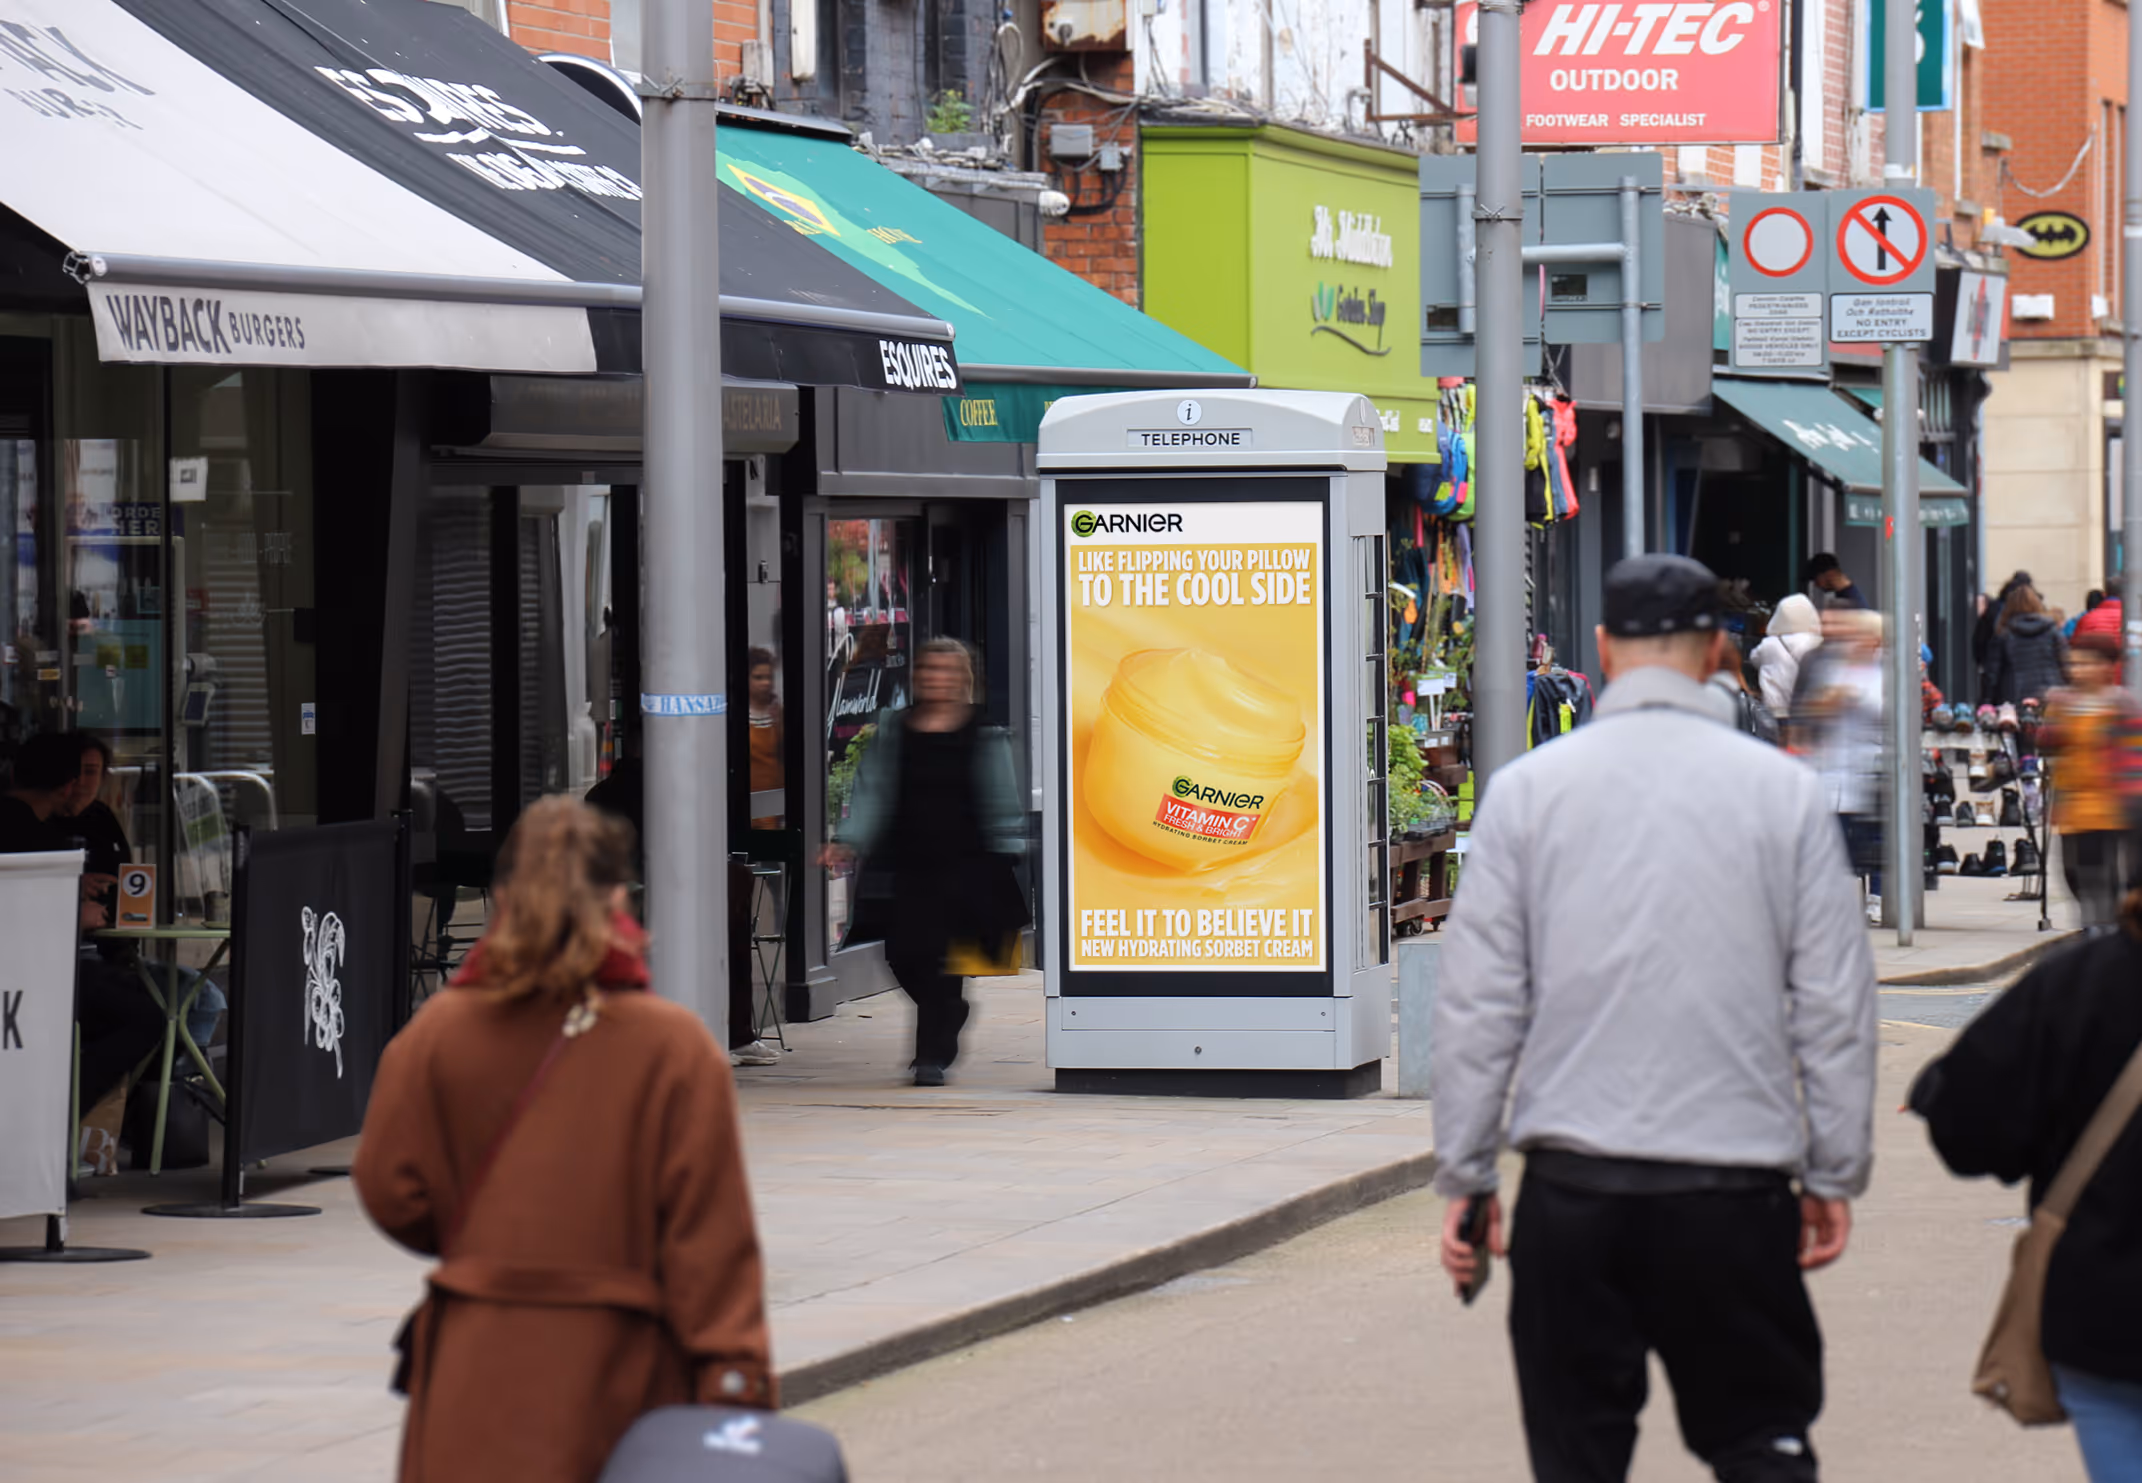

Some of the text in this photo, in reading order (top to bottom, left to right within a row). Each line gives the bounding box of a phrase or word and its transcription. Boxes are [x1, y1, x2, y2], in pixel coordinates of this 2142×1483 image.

[1532, 2, 1755, 56] HI-TEC
[1550, 69, 1679, 91] OUTDOOR
[1526, 113, 1707, 127] FOOTWEAR SPECIALIST
[106, 295, 305, 354] WAYBACK BURGERS
[1837, 329, 1927, 338] EXCEPT CYCLISTS
[1856, 319, 1907, 327] NO ENTRY
[879, 340, 957, 390] ESQUIRES
[960, 400, 998, 426] COFFEE
[1142, 432, 1240, 446] TELEPHONE
[1073, 512, 1183, 534] GARNIER
[1078, 549, 1311, 572] LIKE FLIPPING YOUR PILLOW
[1078, 571, 1312, 607] TO THE COOL SIDE
[1174, 778, 1264, 809] GARNIER
[1163, 814, 1245, 838] FRESH & BRIGHT
[1167, 801, 1232, 829] VITAMIN
[1152, 820, 1190, 839] HYDRATING
[1192, 834, 1222, 844] SORBET
[129, 873, 145, 895] 9
[1081, 909, 1313, 937] FEEL IT TO BELIEVE IT
[1081, 939, 1313, 957] NEW HYDRATING SORBET CREAM
[3, 990, 23, 1049] K
